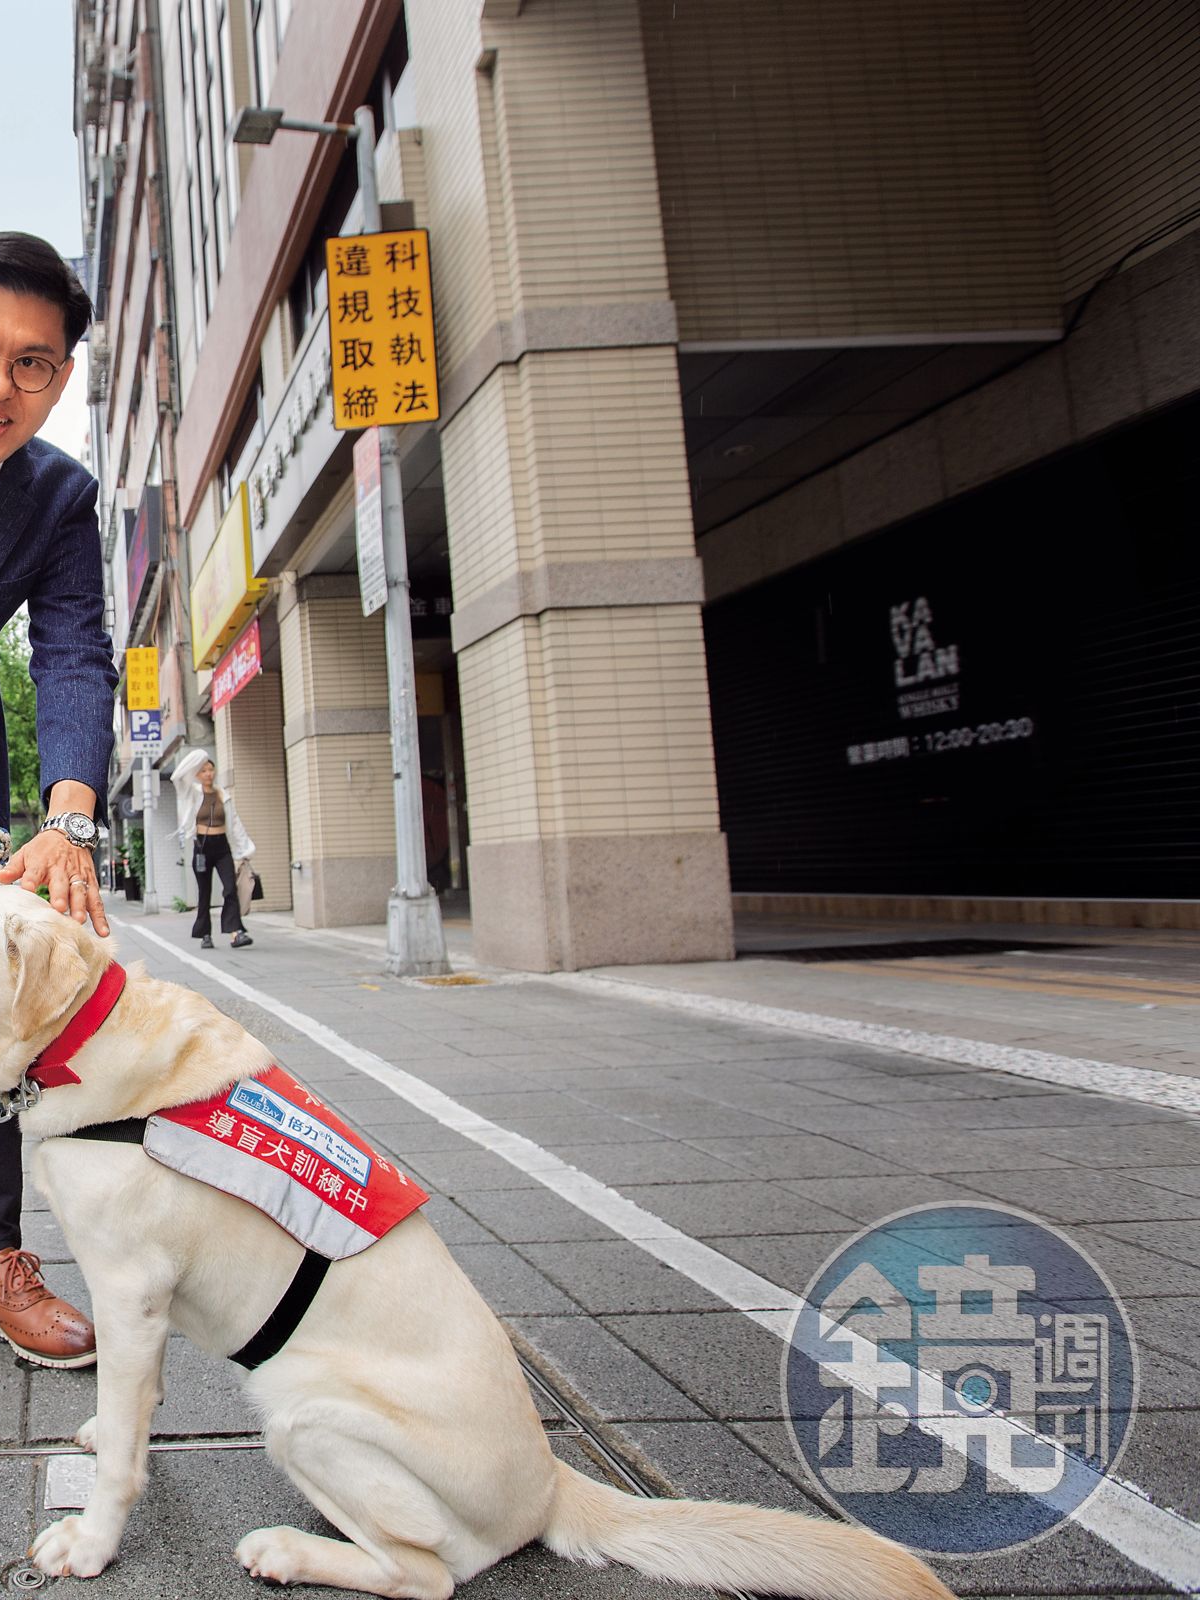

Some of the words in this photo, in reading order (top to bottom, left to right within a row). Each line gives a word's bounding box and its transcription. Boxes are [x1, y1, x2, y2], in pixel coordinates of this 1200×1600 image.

[334, 244, 379, 419] 違規取締
[384, 239, 429, 415] 科技執法
[894, 644, 960, 687] LAN
[132, 711, 150, 733] P
[238, 1091, 263, 1110] BLUE
[263, 1105, 280, 1118] BAY
[288, 1116, 319, 1141] 倍力
[205, 1109, 369, 1214] 導盲犬訓練中
[335, 1145, 359, 1164] always
